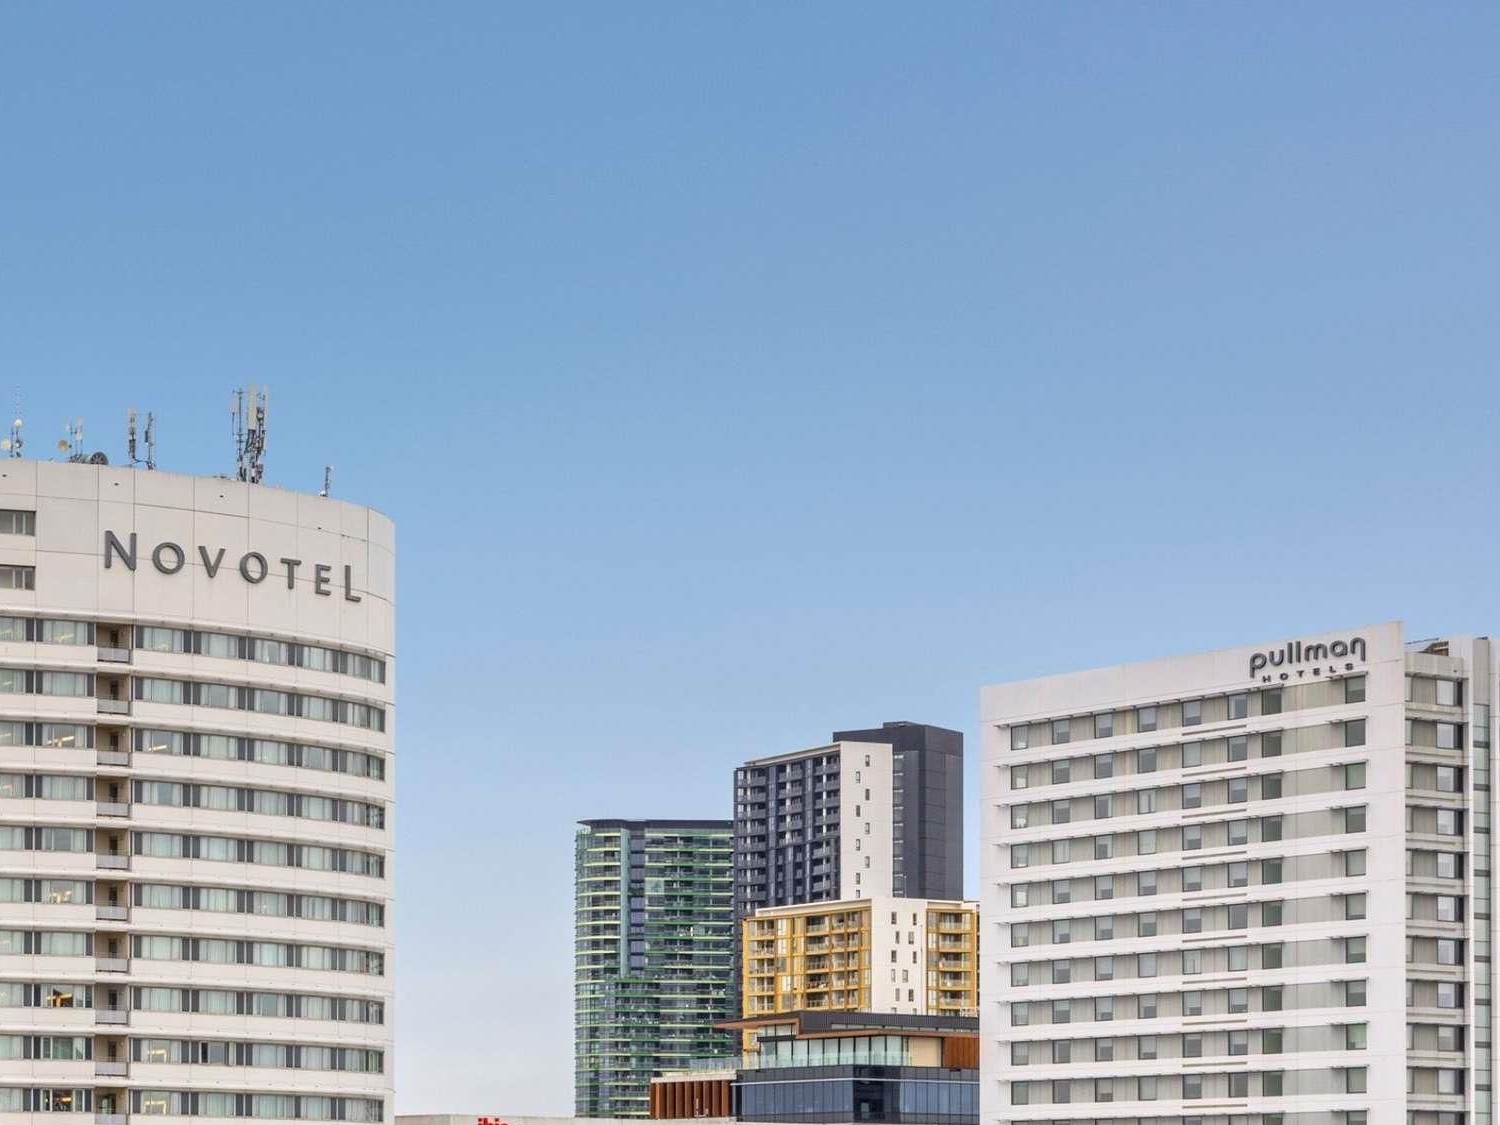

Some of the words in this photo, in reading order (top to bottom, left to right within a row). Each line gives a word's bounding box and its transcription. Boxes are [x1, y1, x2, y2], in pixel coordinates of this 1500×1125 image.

[104, 530, 362, 603] NOVOTEL
[1249, 637, 1366, 679] pullman
[1262, 663, 1354, 683] HOTELS
